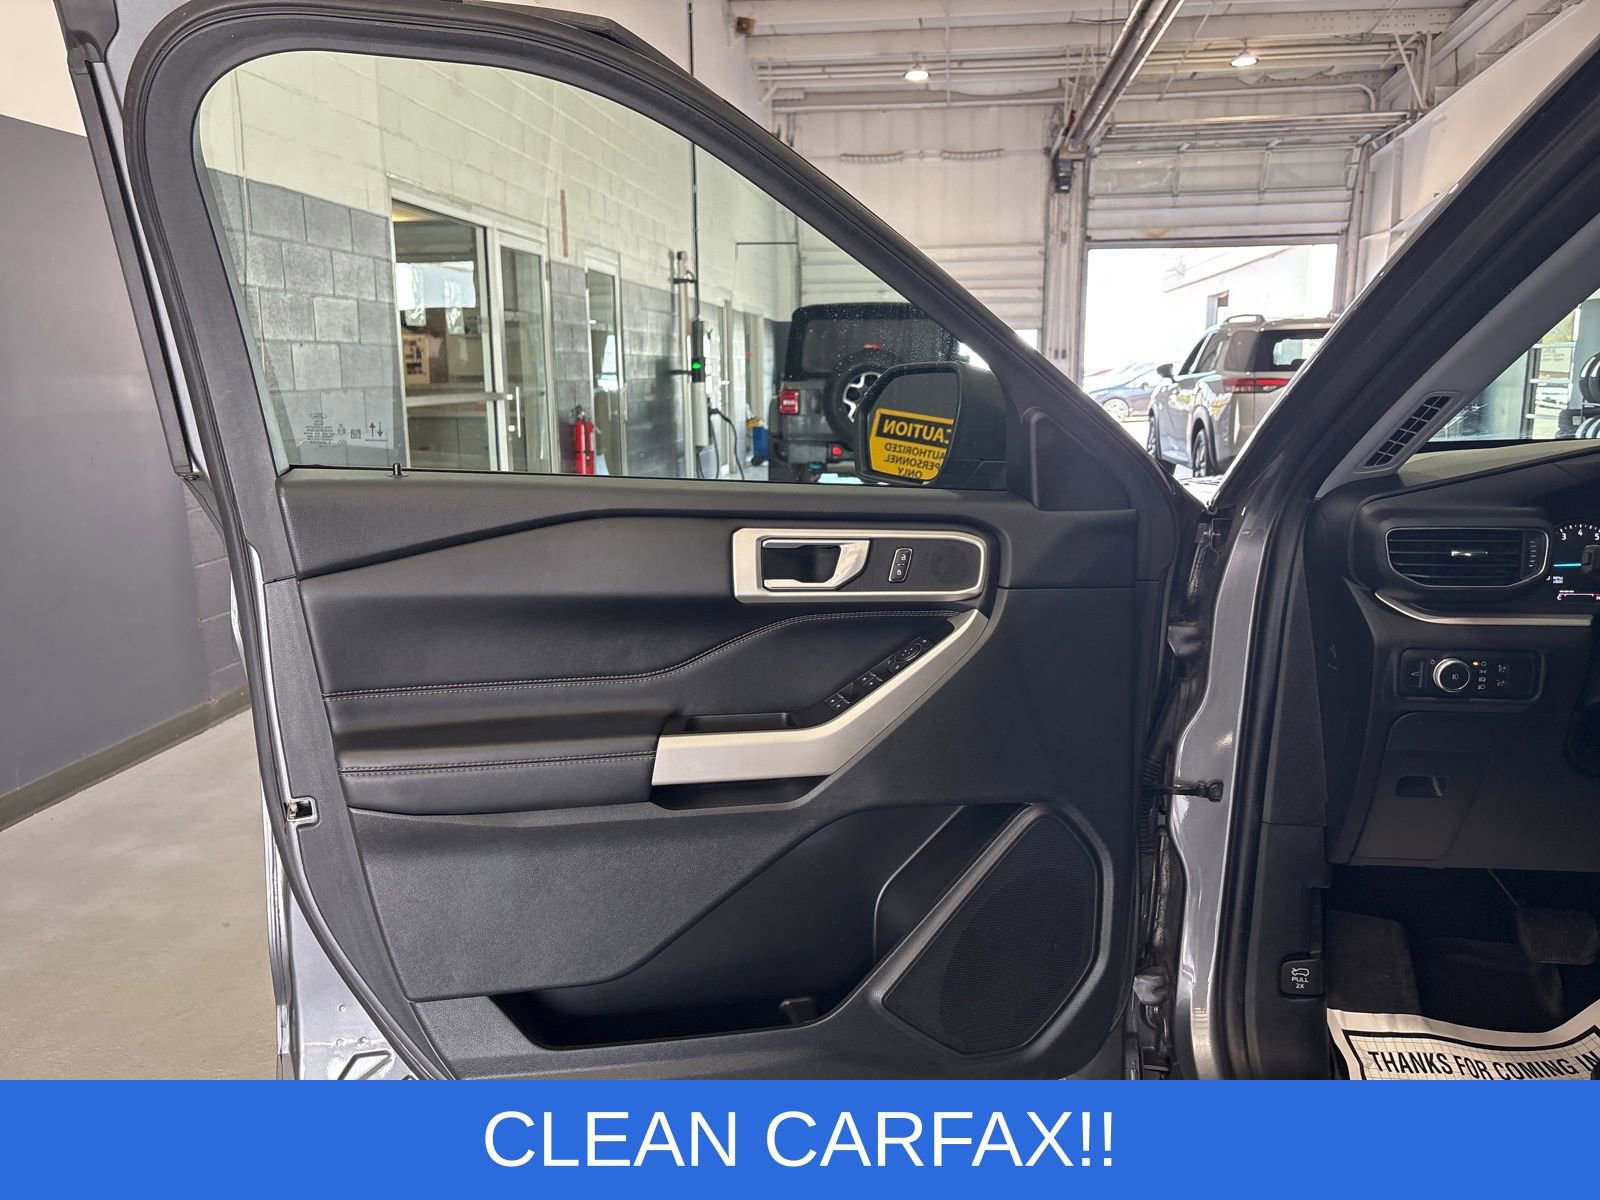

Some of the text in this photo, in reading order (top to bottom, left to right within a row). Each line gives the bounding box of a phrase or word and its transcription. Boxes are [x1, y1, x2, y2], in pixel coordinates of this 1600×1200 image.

[1368, 1051, 1600, 1080] THANKS FOR COMING IN
